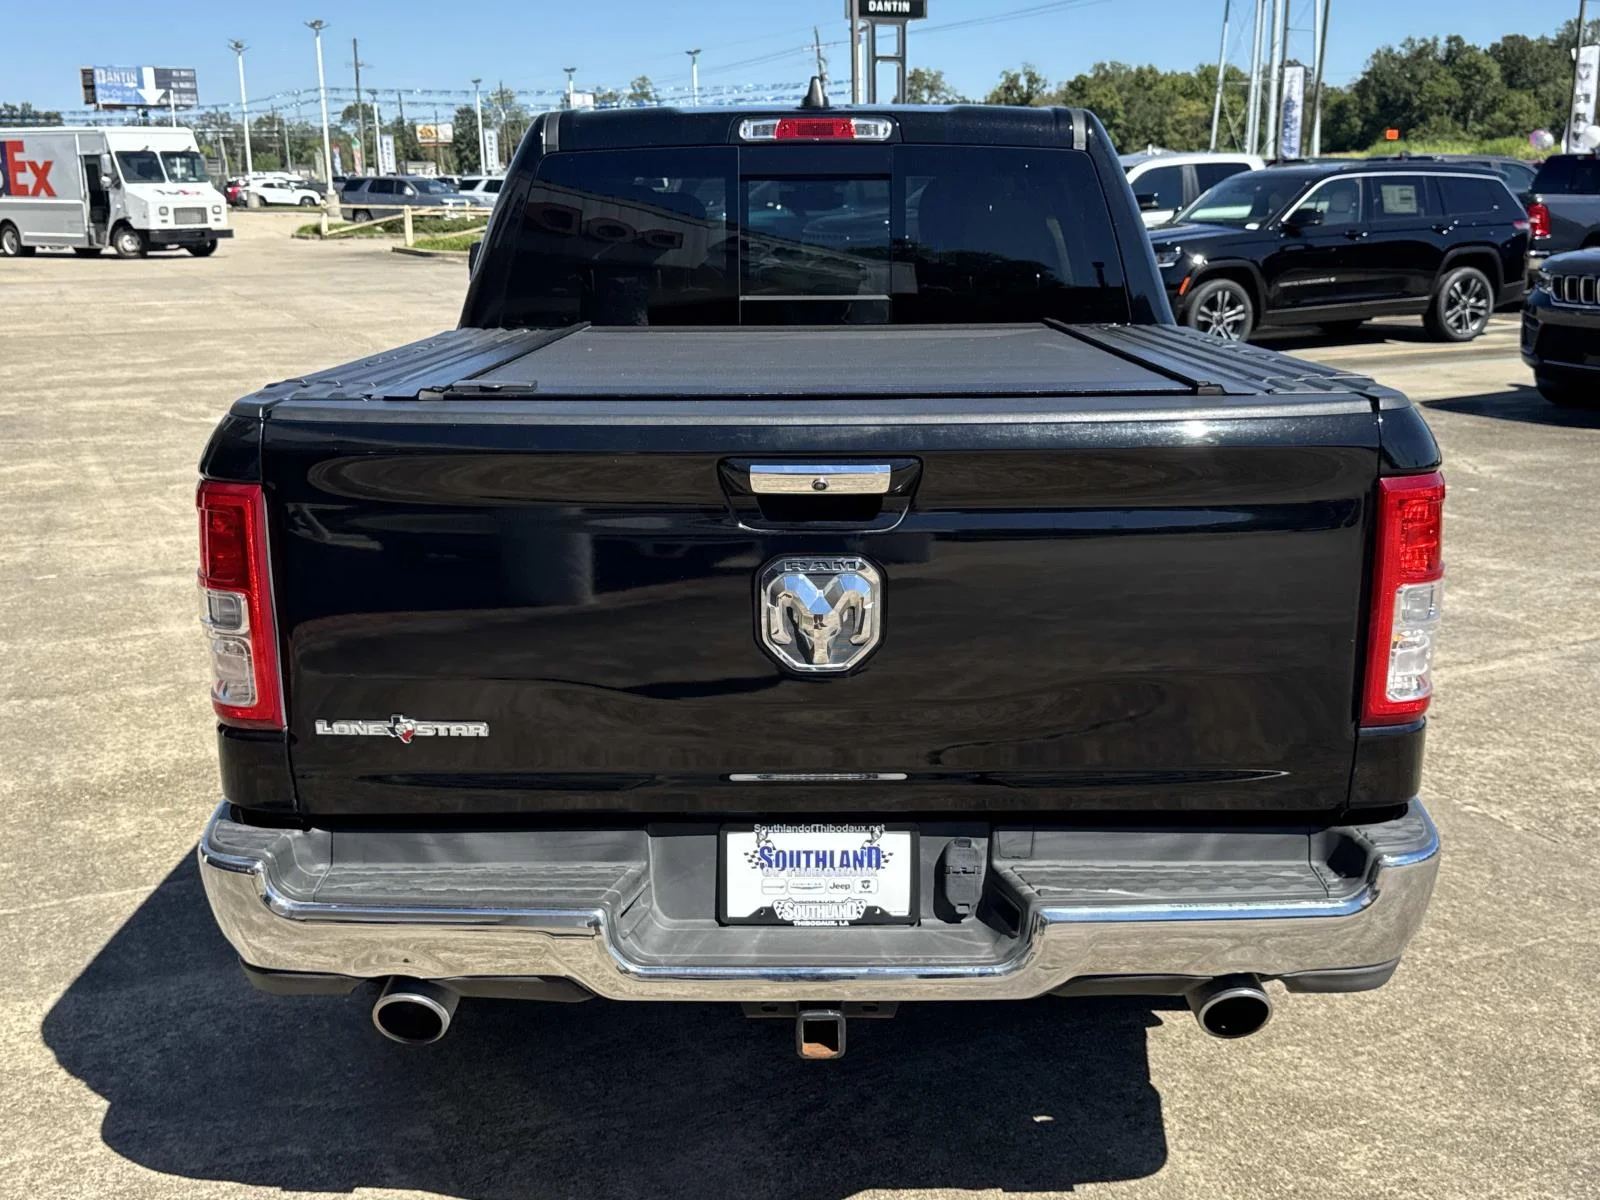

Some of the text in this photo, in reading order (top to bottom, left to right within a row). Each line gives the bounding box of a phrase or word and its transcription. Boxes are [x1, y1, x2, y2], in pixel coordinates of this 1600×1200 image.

[868, 1, 910, 13] DANTIN
[95, 68, 137, 84] DANTIN
[784, 560, 860, 572] RAM
[315, 720, 490, 737] LONE STAR
[754, 824, 885, 833] SouthlandofThibodaux.net
[759, 846, 882, 871] SOUTHLAND
[829, 882, 851, 891] Jeep
[783, 901, 857, 919] SOUTHLAND
